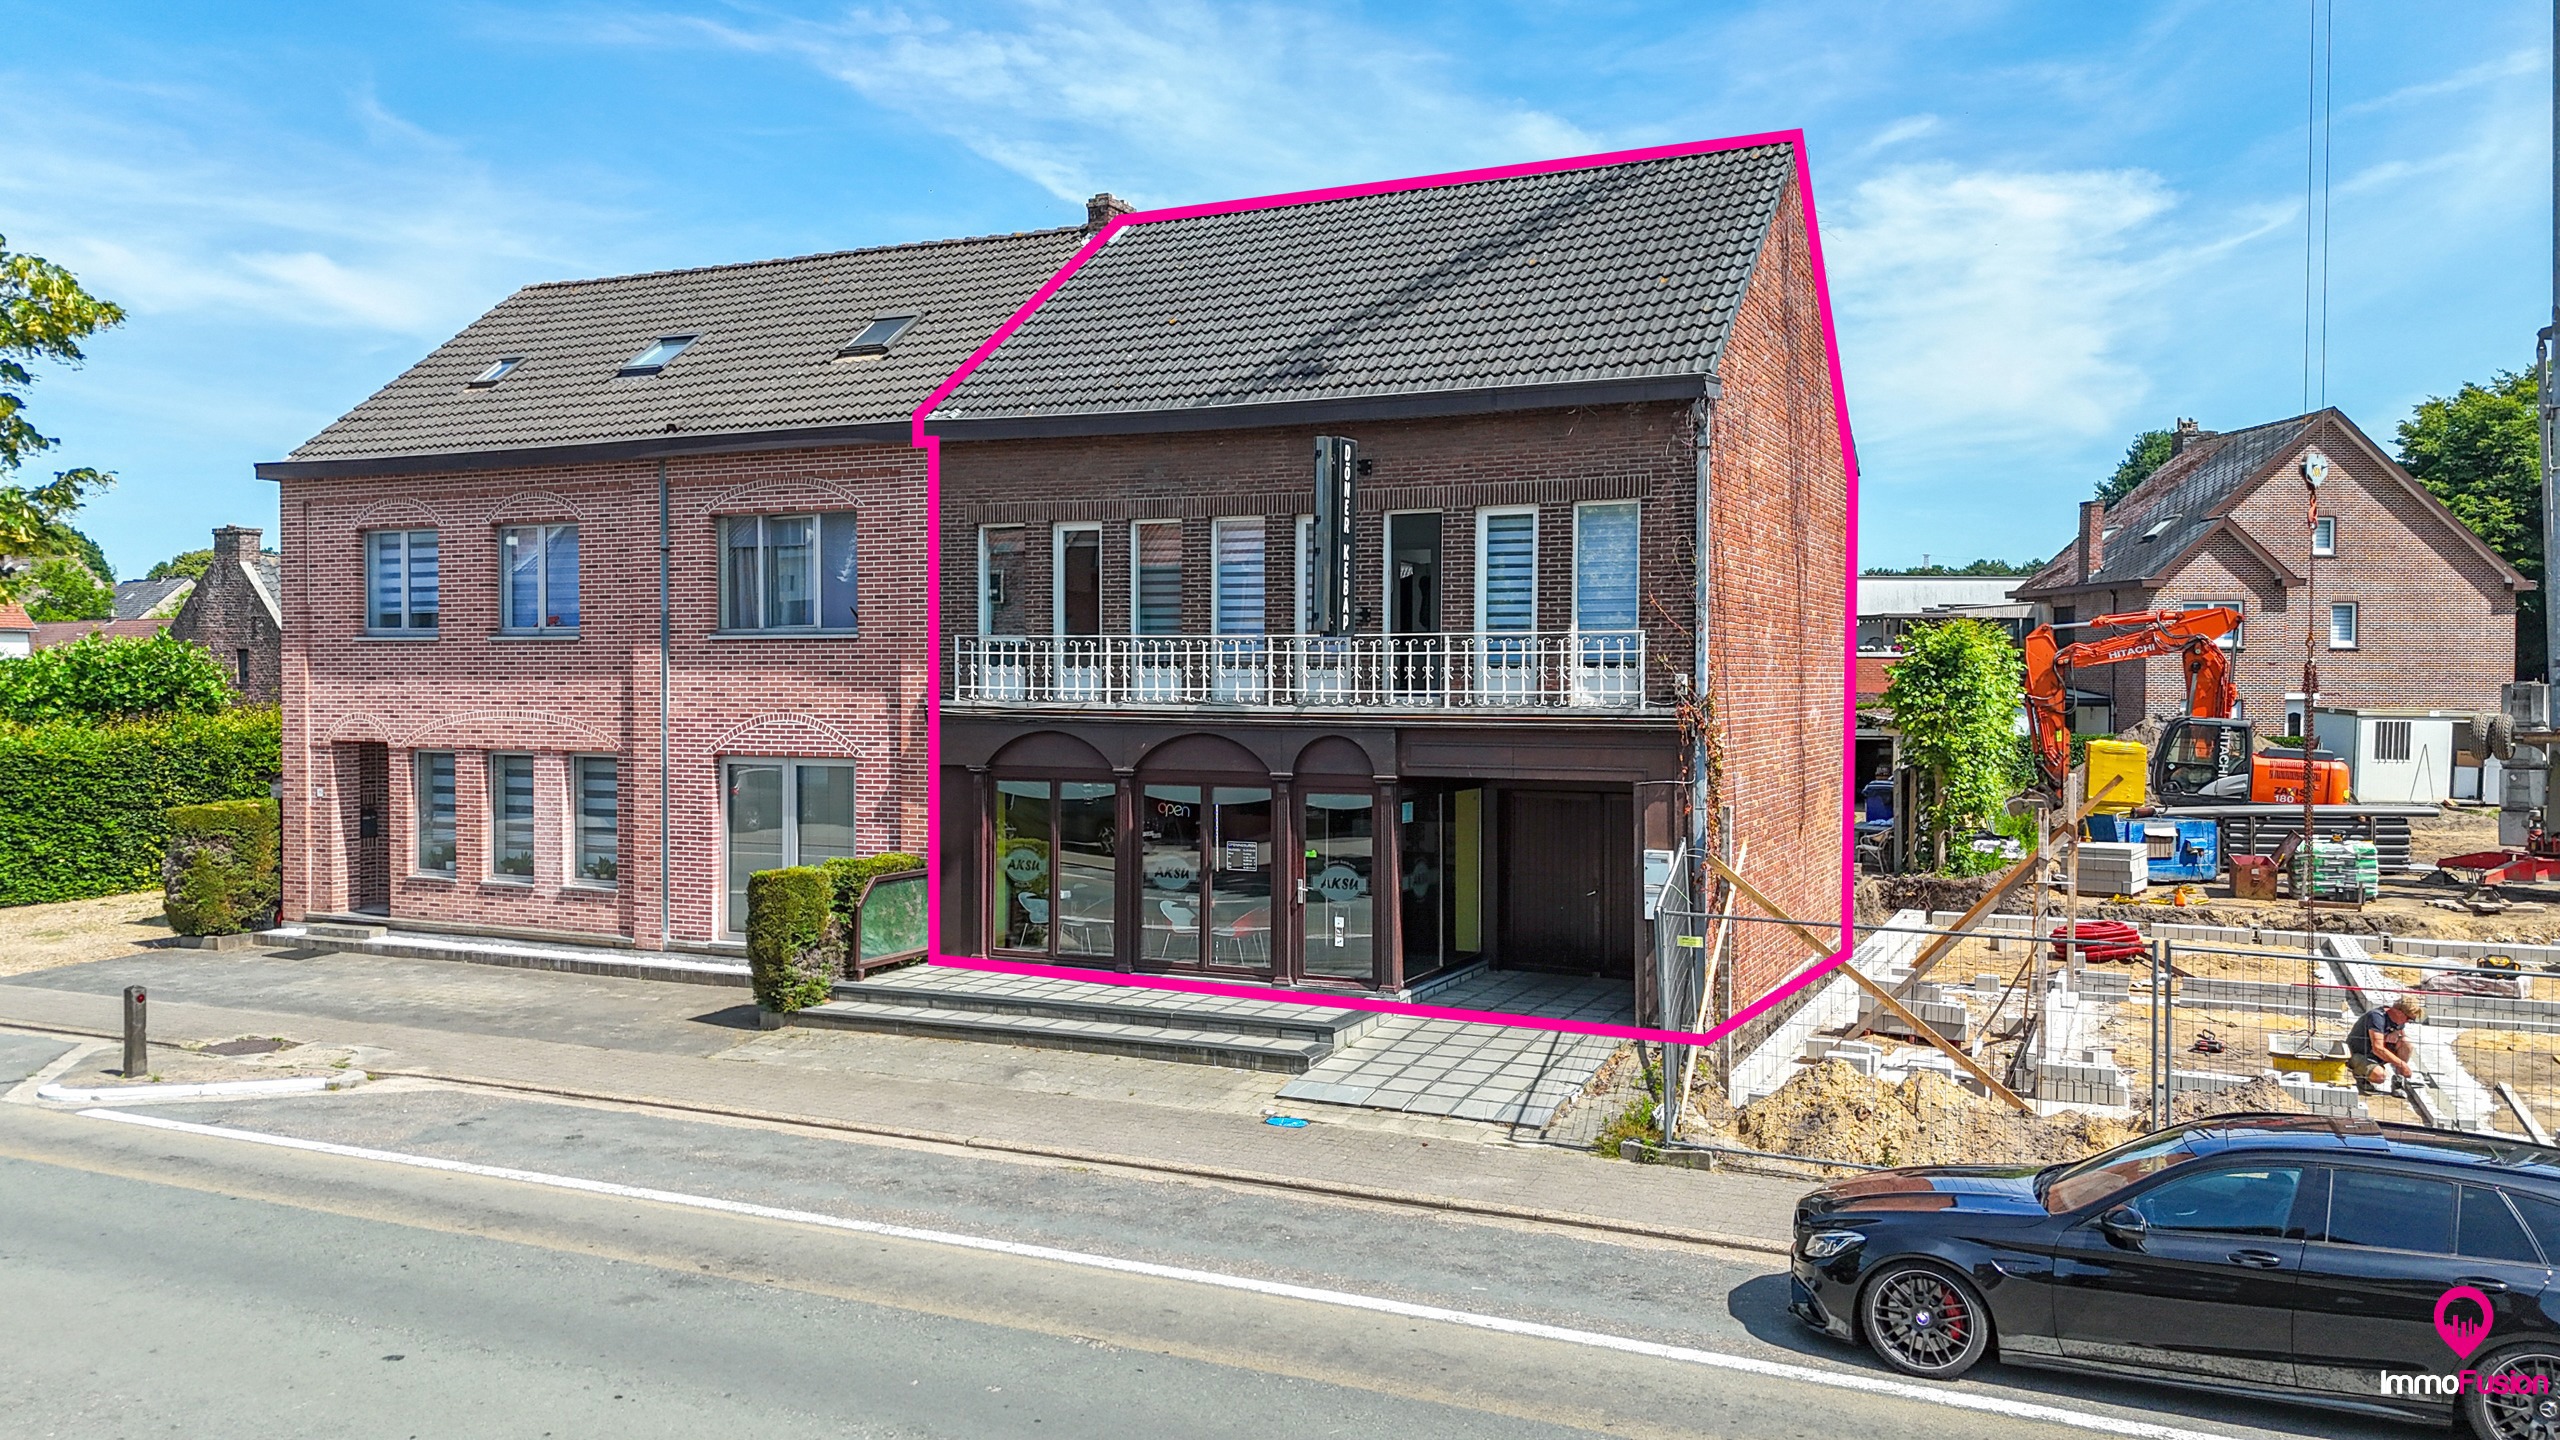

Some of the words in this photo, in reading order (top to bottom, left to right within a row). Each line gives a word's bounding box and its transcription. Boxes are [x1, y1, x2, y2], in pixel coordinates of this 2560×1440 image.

[1343, 444, 1351, 534] DÖNER
[1342, 544, 1350, 631] KEBAP
[2108, 643, 2156, 659] HITACHI
[2218, 726, 2231, 777] HITACHI
[2274, 786, 2305, 797] ZAXIS
[2274, 794, 2294, 803] 180
[1158, 802, 1190, 817] open
[1007, 859, 1040, 870] AKSU
[1154, 866, 1189, 879] AKSU
[1320, 877, 1359, 890] AKSU
